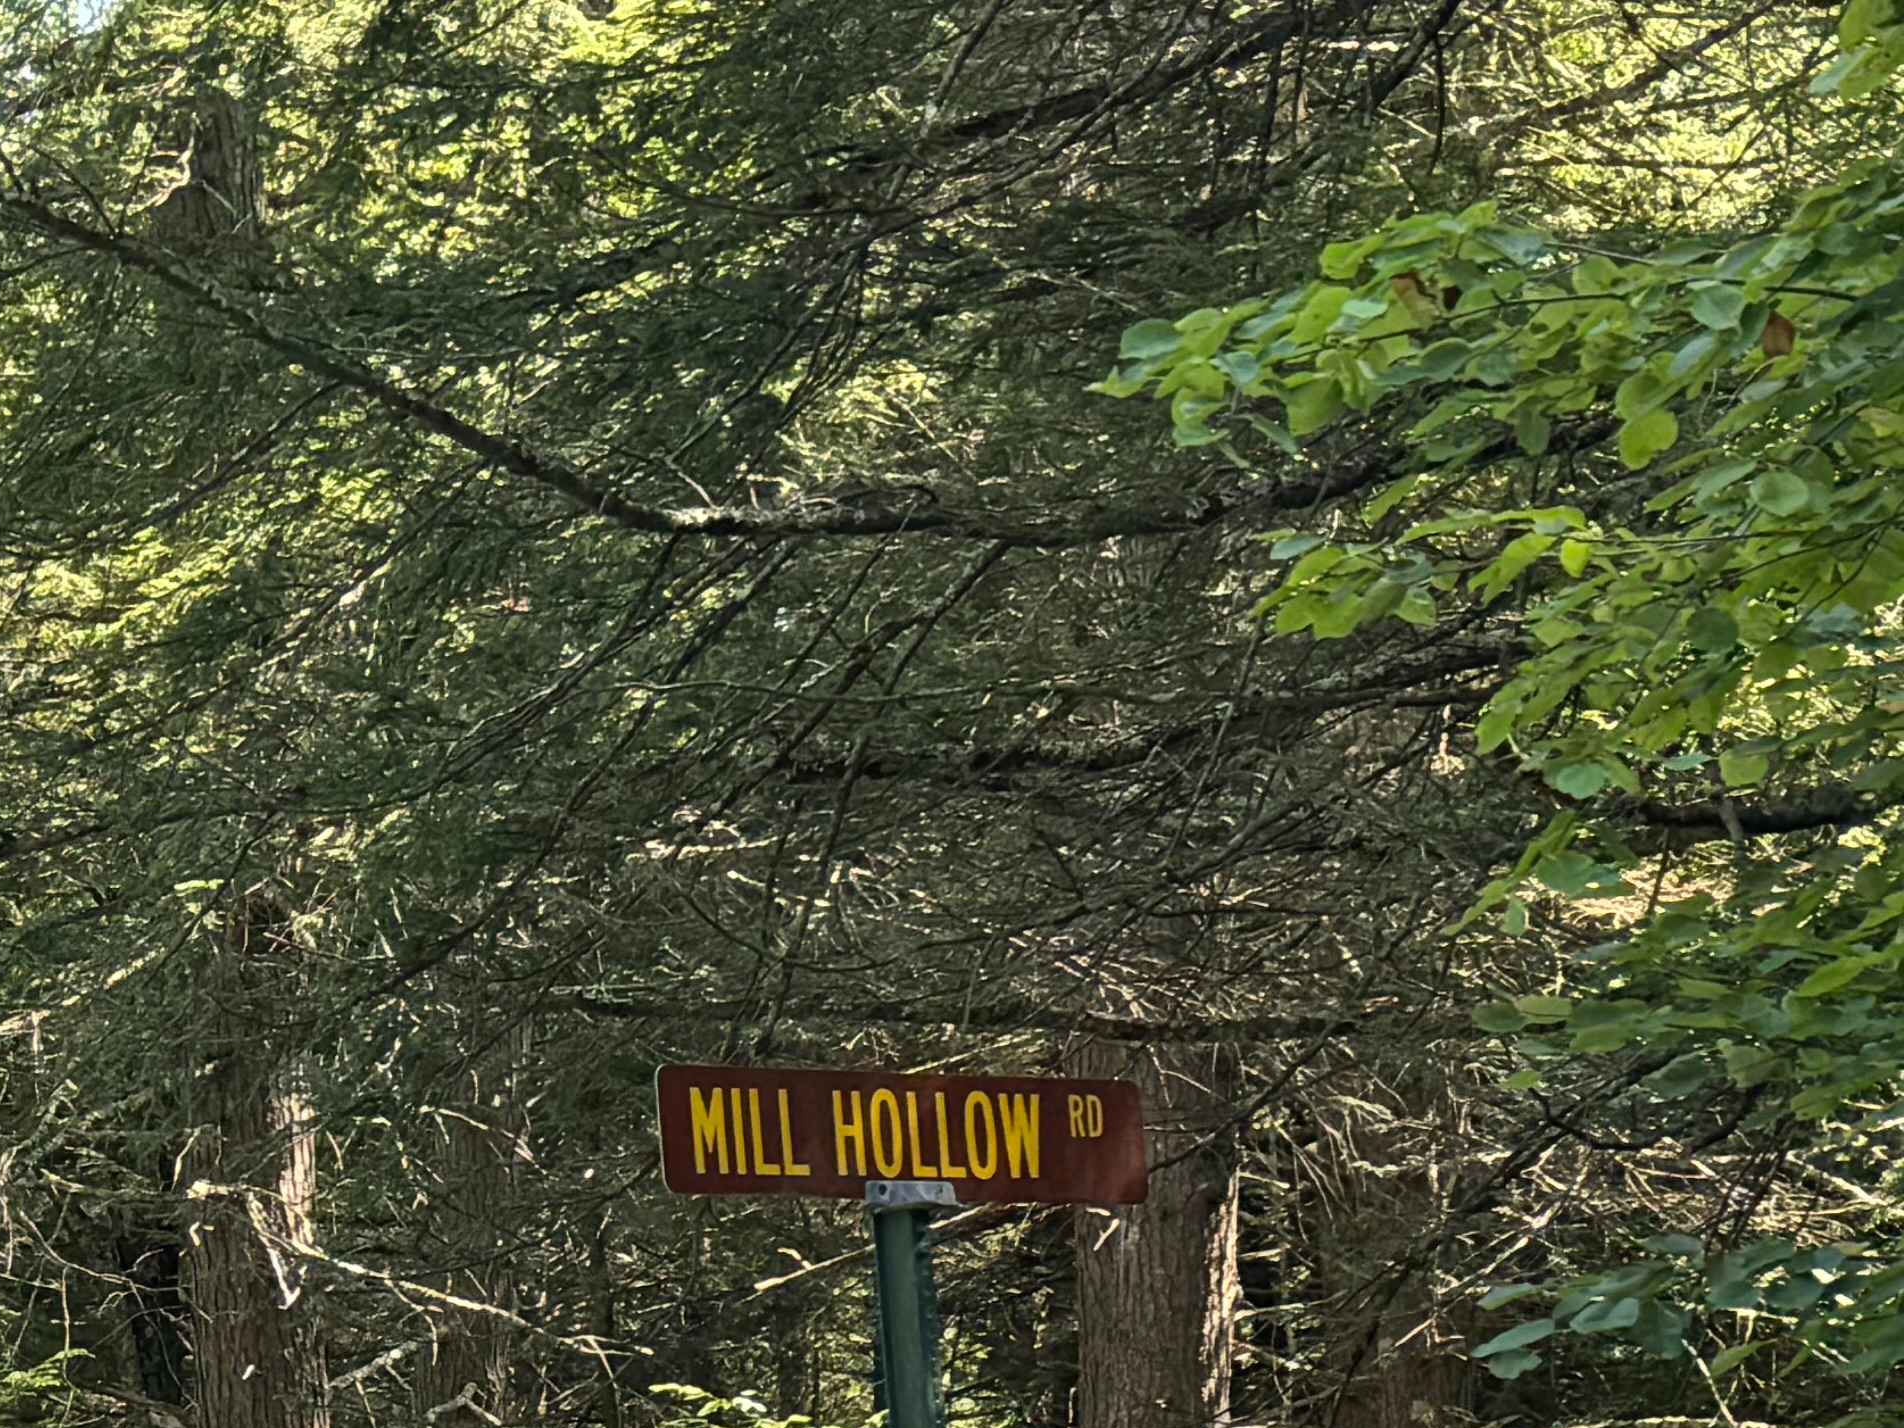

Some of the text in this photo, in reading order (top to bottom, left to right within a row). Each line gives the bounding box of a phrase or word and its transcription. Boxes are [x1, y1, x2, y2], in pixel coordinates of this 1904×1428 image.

[689, 1087, 1104, 1179] MILL HOLLOW RD
